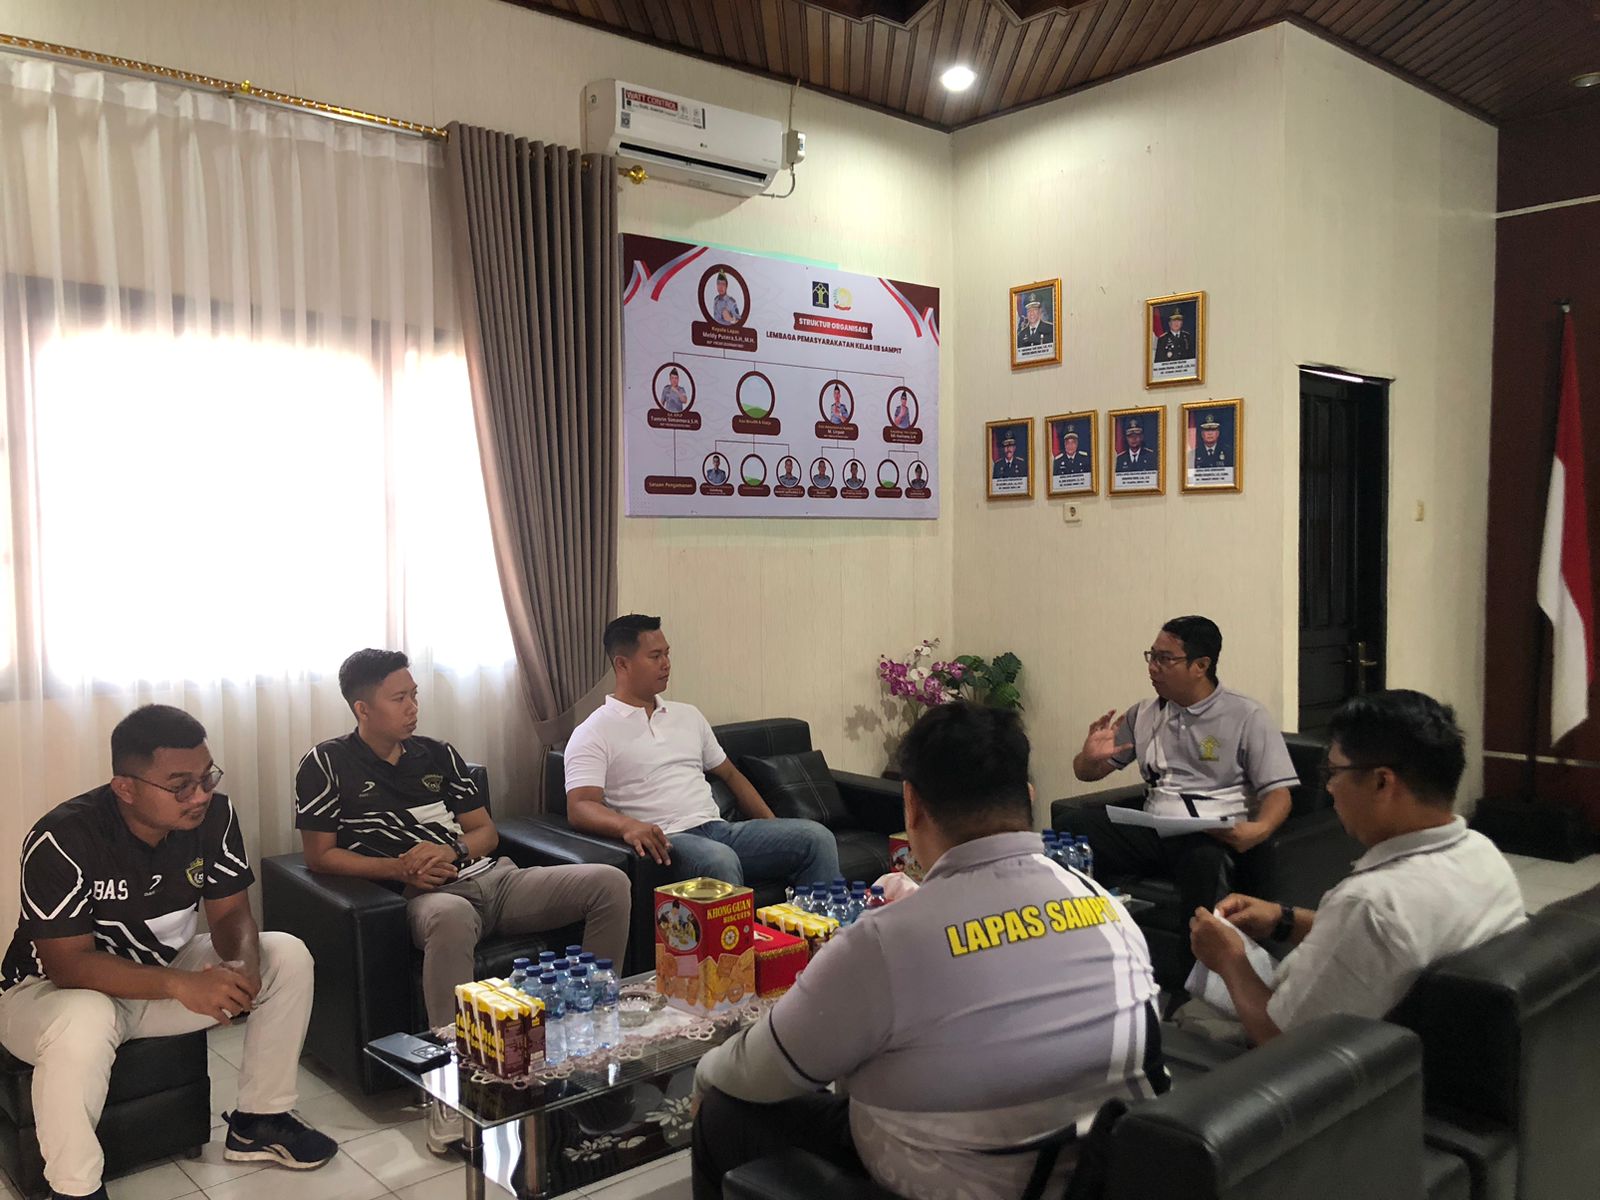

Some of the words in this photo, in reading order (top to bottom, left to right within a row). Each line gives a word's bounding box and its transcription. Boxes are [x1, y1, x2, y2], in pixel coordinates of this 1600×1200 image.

[646, 96, 676, 110] CONTROL
[798, 317, 831, 329] STRUKTUR
[831, 323, 869, 334] ORGANISASI
[766, 331, 796, 342] LEMBAGA
[797, 334, 855, 348] PEMASYARAKATAN
[855, 341, 873, 351] KELAS
[873, 344, 881, 352] IIB
[881, 345, 902, 354] SAMPIT
[92, 879, 129, 901] BAS
[706, 903, 732, 921] KHONG
[732, 898, 751, 913] GUAN
[723, 910, 751, 924] BISCUITS
[946, 904, 1046, 957] LAPAS
